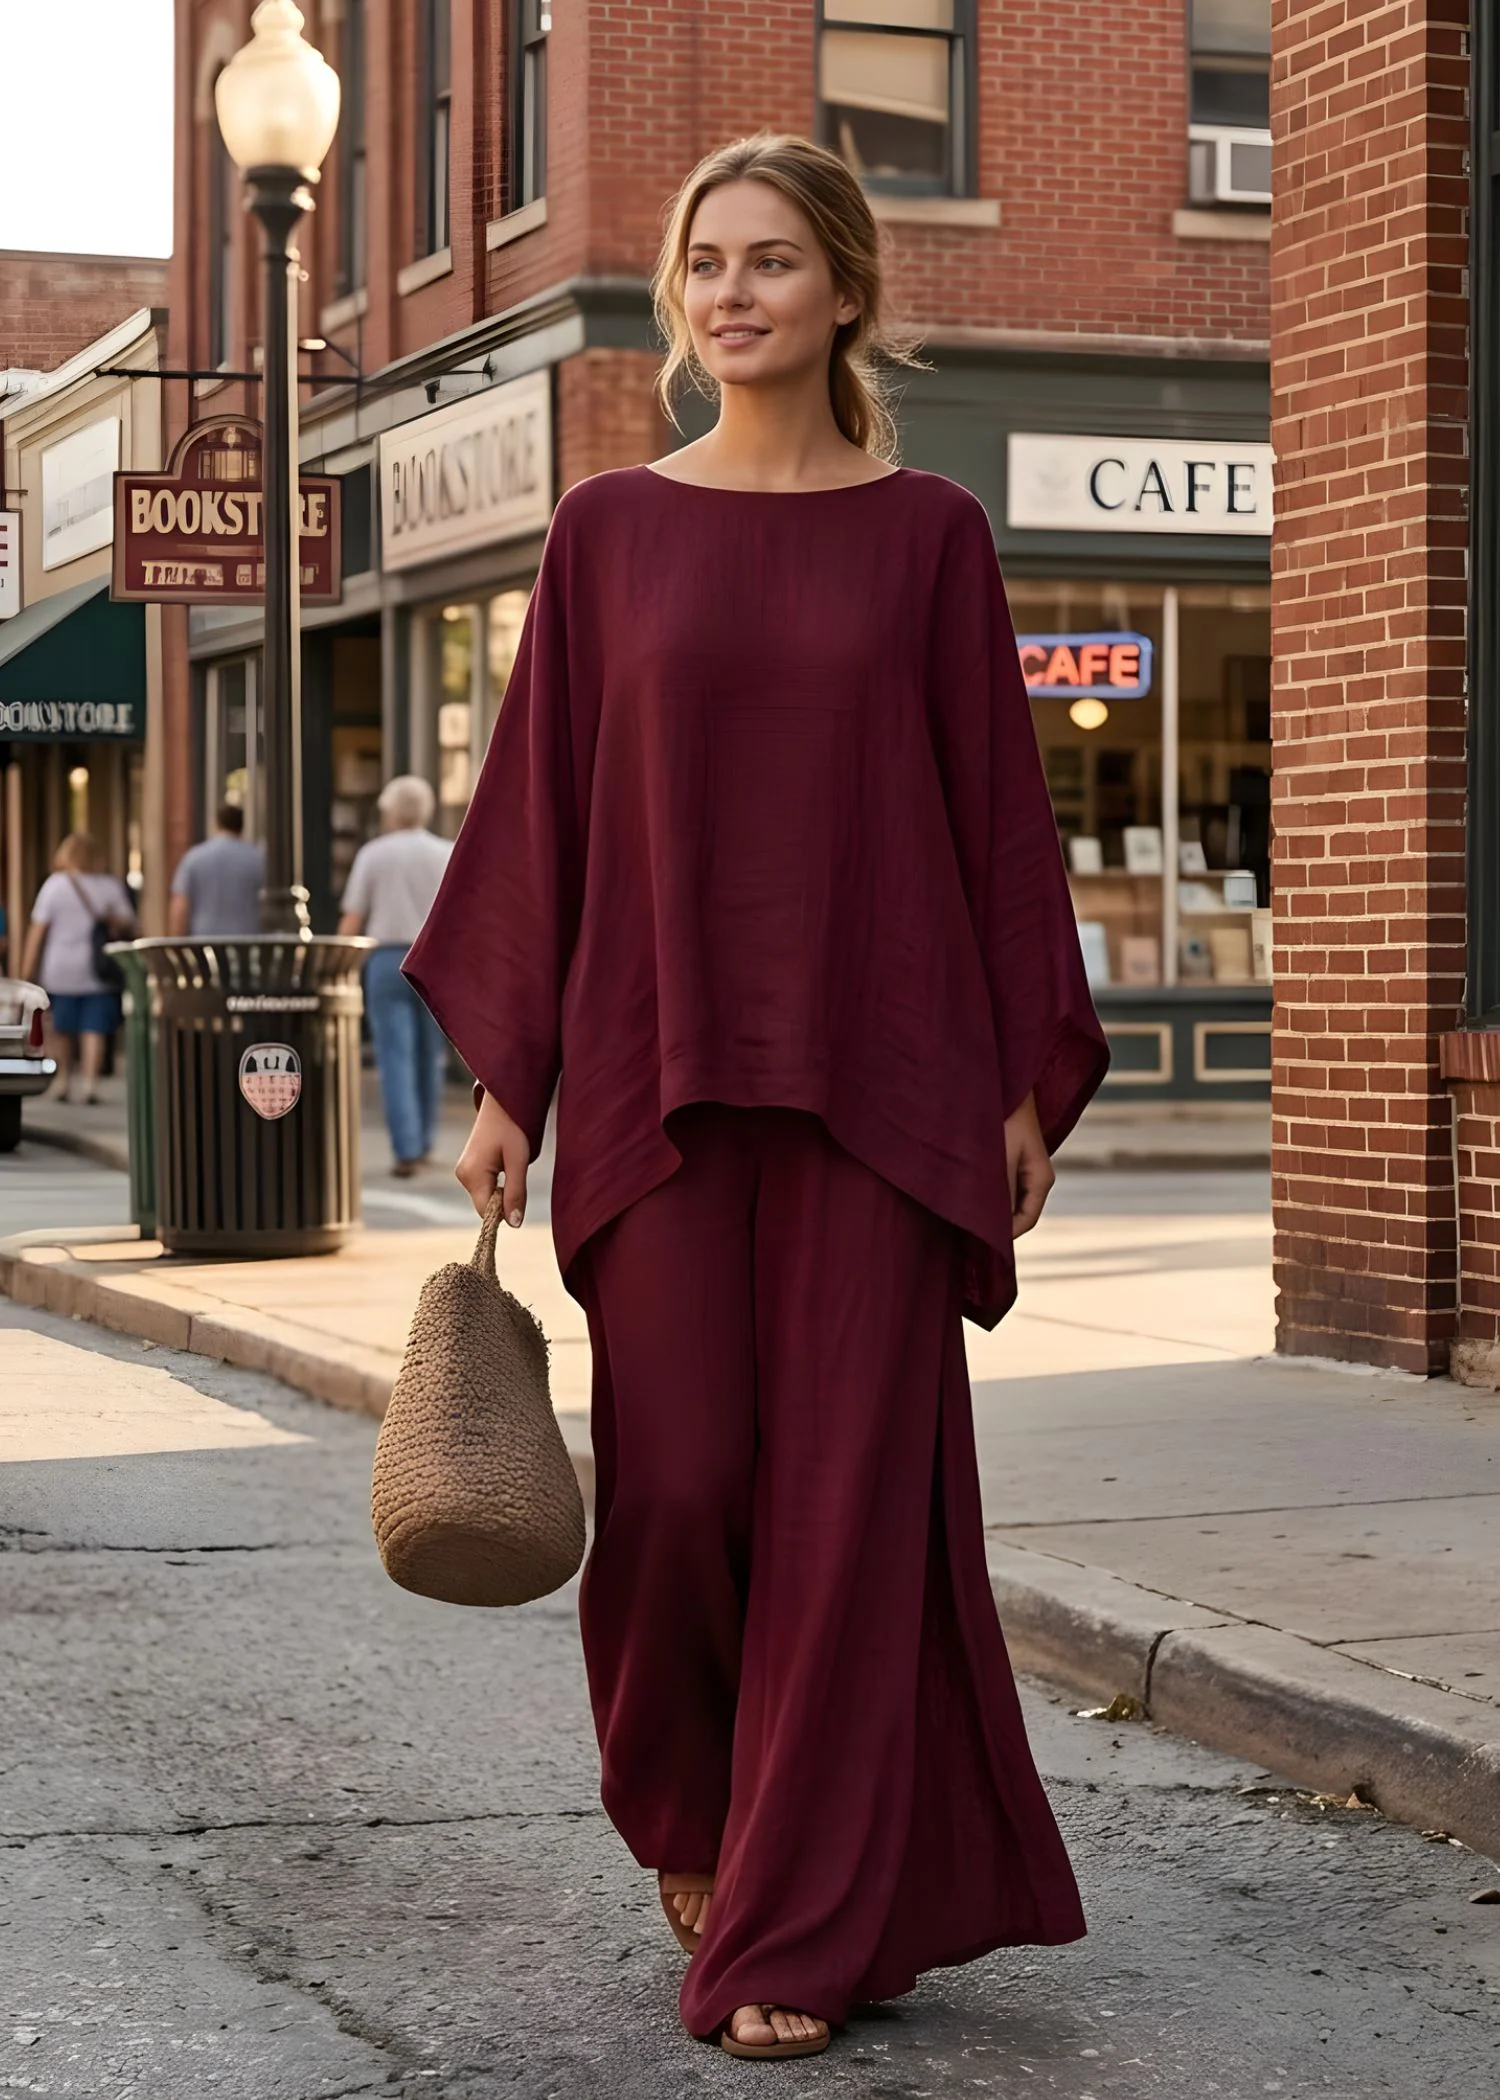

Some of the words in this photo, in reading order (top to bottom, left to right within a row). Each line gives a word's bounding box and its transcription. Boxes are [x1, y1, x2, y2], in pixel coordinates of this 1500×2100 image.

[1088, 458, 1258, 514] CAFE
[131, 488, 328, 537] BOOKSTE
[1016, 643, 1140, 688] CAFE
